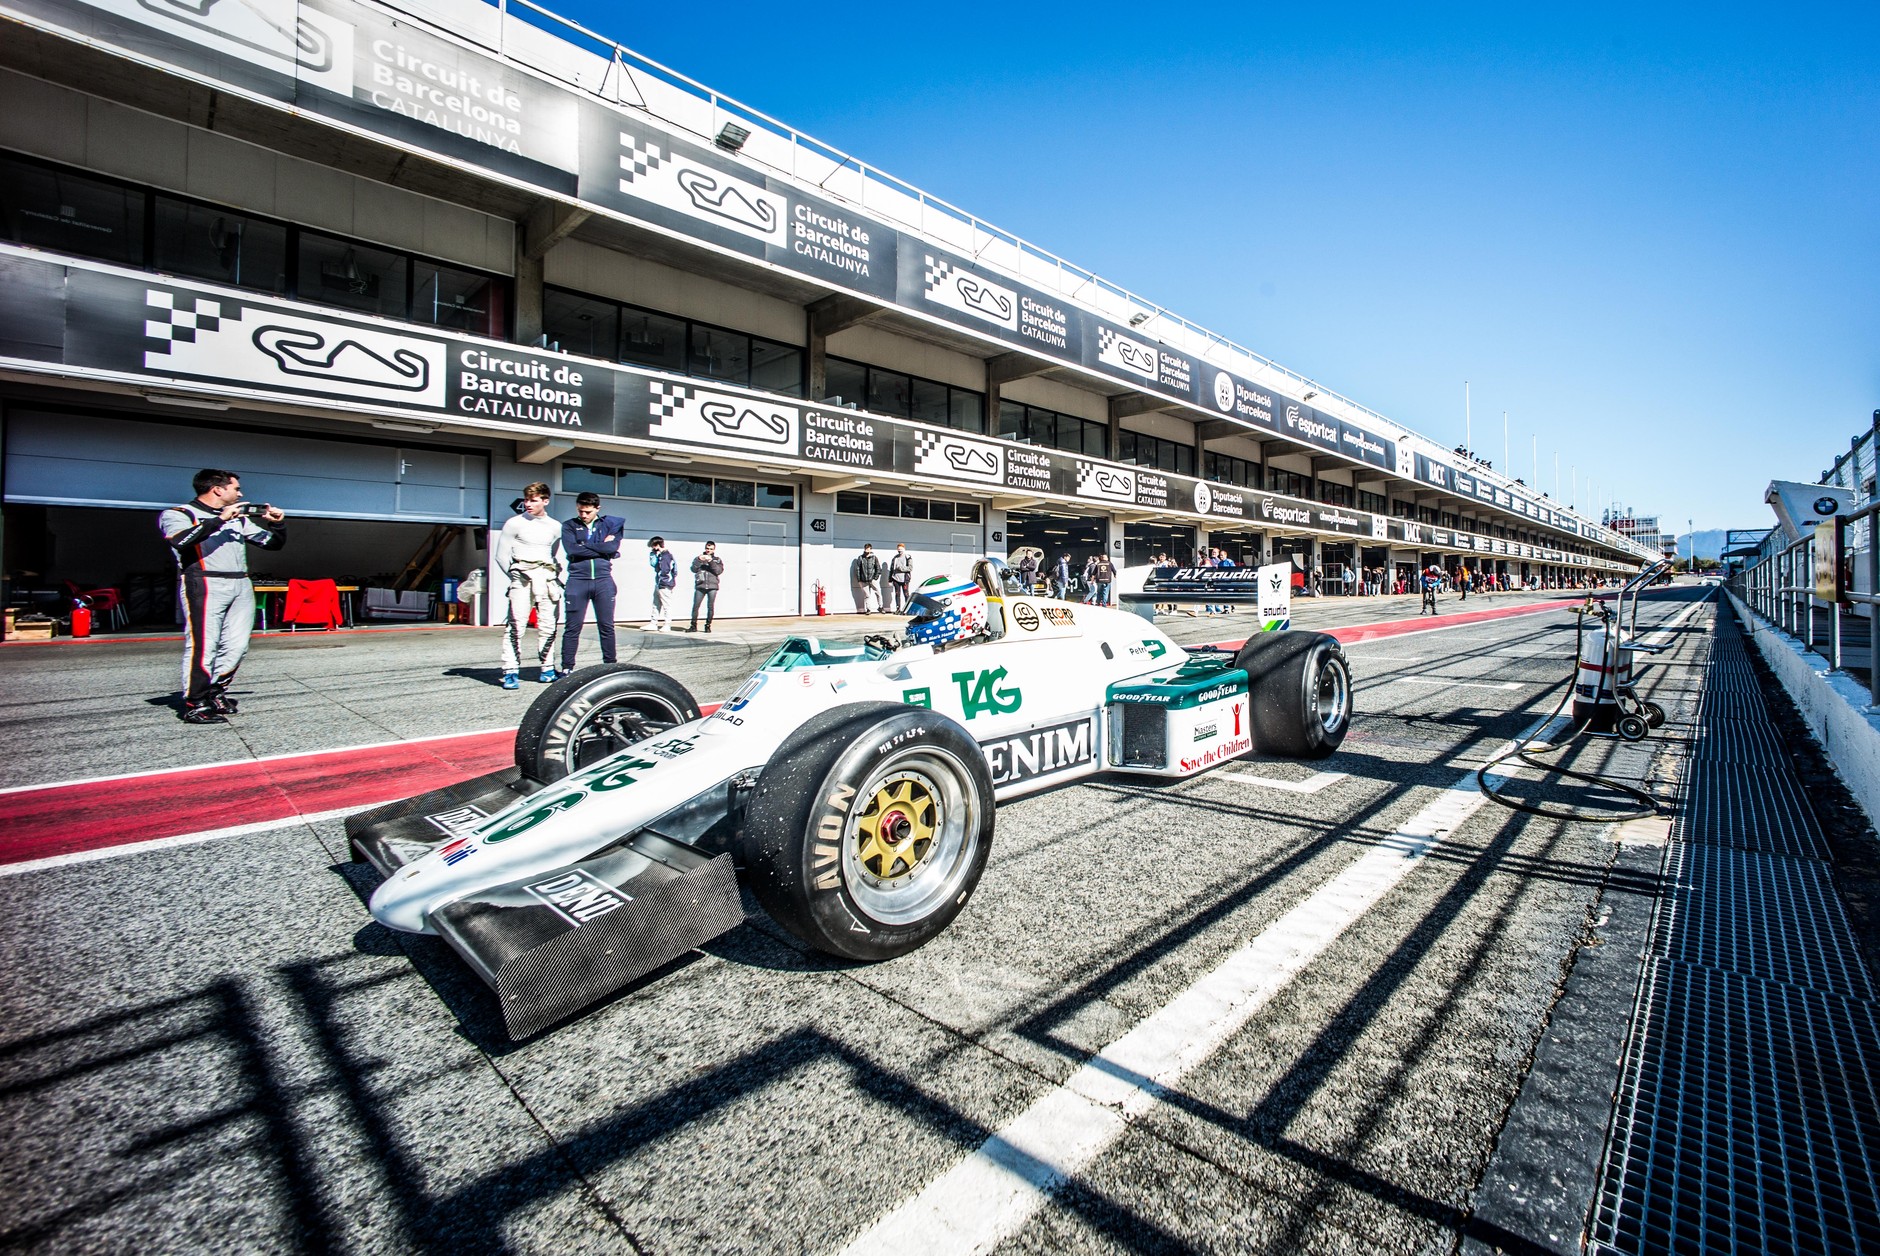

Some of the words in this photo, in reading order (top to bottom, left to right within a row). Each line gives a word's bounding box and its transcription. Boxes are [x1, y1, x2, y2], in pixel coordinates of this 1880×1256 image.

[373, 39, 481, 98] Circuit
[487, 86, 521, 113] de
[373, 62, 521, 135] Barcelona
[372, 90, 523, 156] CATALUNYA
[795, 204, 849, 238] Circuit
[851, 226, 869, 245] de
[795, 221, 869, 262] Barcelona
[794, 240, 869, 277] CATALUNYA
[1021, 296, 1054, 319] Circuit
[1054, 309, 1066, 324] de
[1021, 309, 1066, 336] Barcelona
[1021, 324, 1066, 349] CATALUNYA
[460, 349, 550, 382] Circuit
[553, 366, 583, 387] de
[1160, 352, 1182, 368] Circuit
[1181, 360, 1190, 372] de
[1160, 363, 1190, 382] Barcelona
[461, 371, 582, 407] Barcelona
[1160, 374, 1190, 392] CATALUNYA
[1236, 383, 1271, 408] Diputació
[459, 395, 582, 426] CATALUNYA
[1236, 401, 1271, 423] Barcelona
[805, 411, 855, 433] Circuit
[857, 421, 874, 436] de
[1298, 416, 1338, 443] esportcat
[806, 428, 874, 451] Barcelona
[805, 445, 874, 466] CATALUNYA
[1007, 449, 1039, 465] Circuit
[1039, 454, 1050, 467] de
[1007, 462, 1050, 479] Barcelona
[1137, 473, 1159, 486] Circuit
[1159, 476, 1167, 487] de
[1007, 475, 1050, 490] CATALUNYA
[1137, 484, 1167, 497] Barcelona
[1137, 495, 1167, 507] CATALUNYA
[1212, 488, 1243, 504] Diputació
[1212, 502, 1243, 516] Barcelona
[1272, 506, 1310, 524] esportcat
[813, 520, 826, 530] 48
[993, 532, 1002, 541] 47
[1017, 606, 1031, 616] ICI
[1040, 607, 1076, 626] RECORD
[1263, 603, 1287, 617] saudia
[991, 630, 1003, 640] erg
[803, 674, 810, 684] E
[951, 664, 1022, 720] TAG
[1112, 693, 1171, 703] GOODYEAR
[1198, 683, 1238, 702] GOODYEAR
[544, 695, 593, 763] AVON
[981, 723, 1089, 785] ENIM
[1180, 757, 1202, 773] Save
[1203, 750, 1216, 765] the
[1217, 738, 1250, 759] Children
[433, 807, 485, 836] DEN
[812, 780, 857, 892] AVON
